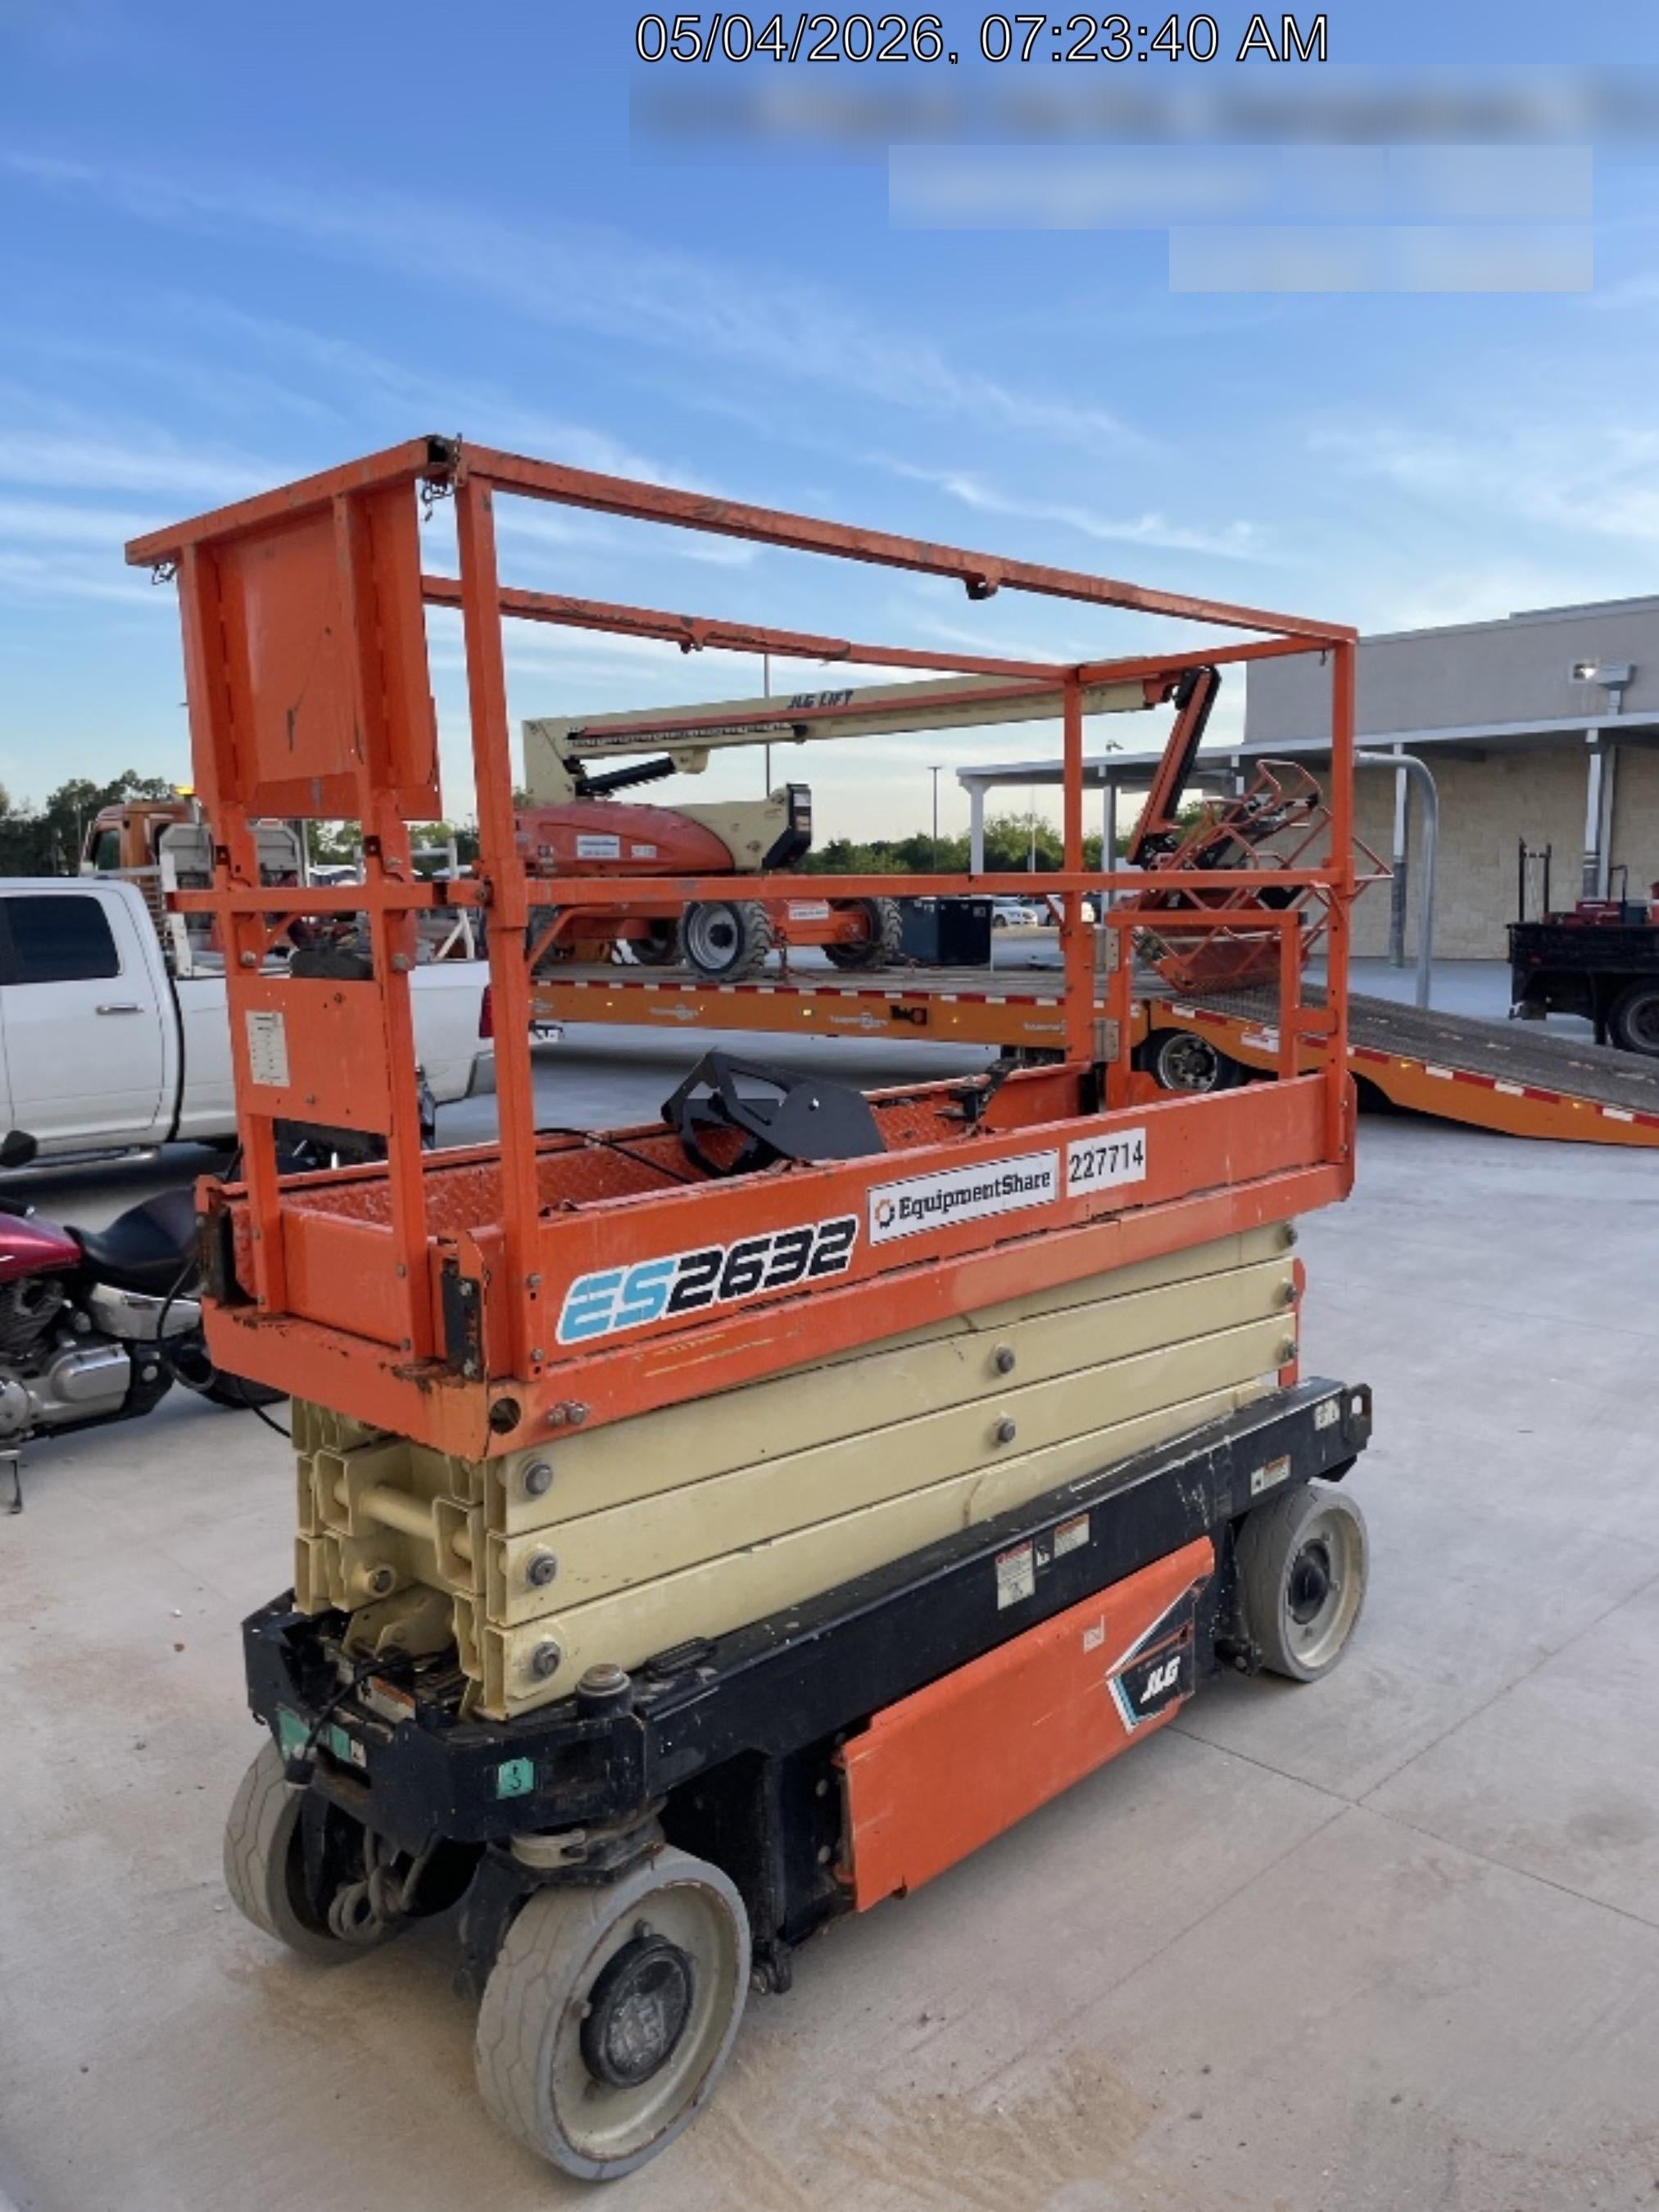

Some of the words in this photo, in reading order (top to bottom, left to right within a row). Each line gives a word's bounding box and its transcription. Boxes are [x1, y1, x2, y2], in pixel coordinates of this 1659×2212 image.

[1068, 1140, 1145, 1183] 227714
[899, 1171, 1052, 1220] EquipmentShare
[559, 1216, 858, 1343] ES2632
[1140, 1655, 1181, 1704] JLG
